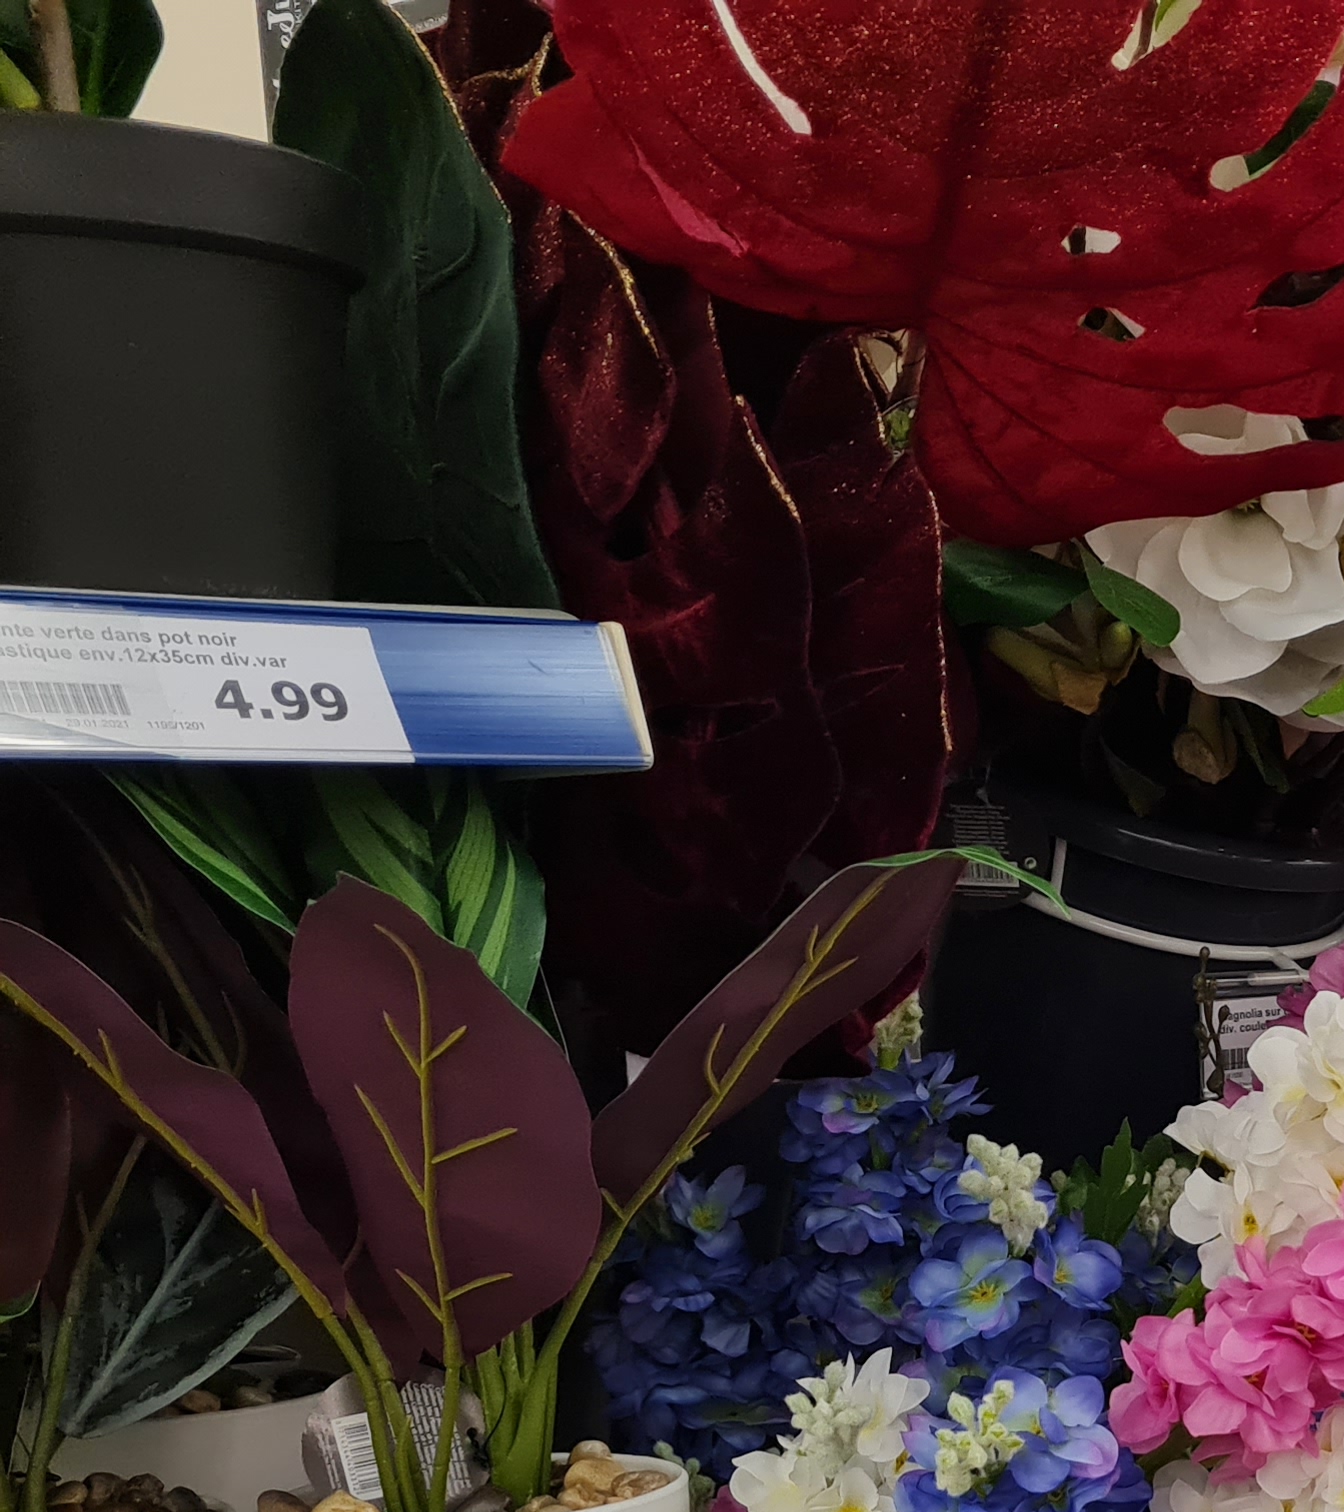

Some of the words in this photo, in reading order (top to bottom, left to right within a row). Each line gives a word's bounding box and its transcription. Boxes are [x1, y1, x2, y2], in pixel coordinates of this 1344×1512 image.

[41, 626, 96, 640] verte
[101, 626, 152, 643] dans
[158, 630, 193, 647] pot
[198, 632, 237, 647] noir
[79, 647, 215, 666] env.12x35cm
[221, 652, 287, 668] div.var
[214, 679, 349, 722] 4.99
[1226, 1008, 1263, 1023] agnolia
[1265, 1007, 1281, 1017] sur
[1220, 1025, 1237, 1035] div.
[1240, 1021, 1268, 1033] coule
